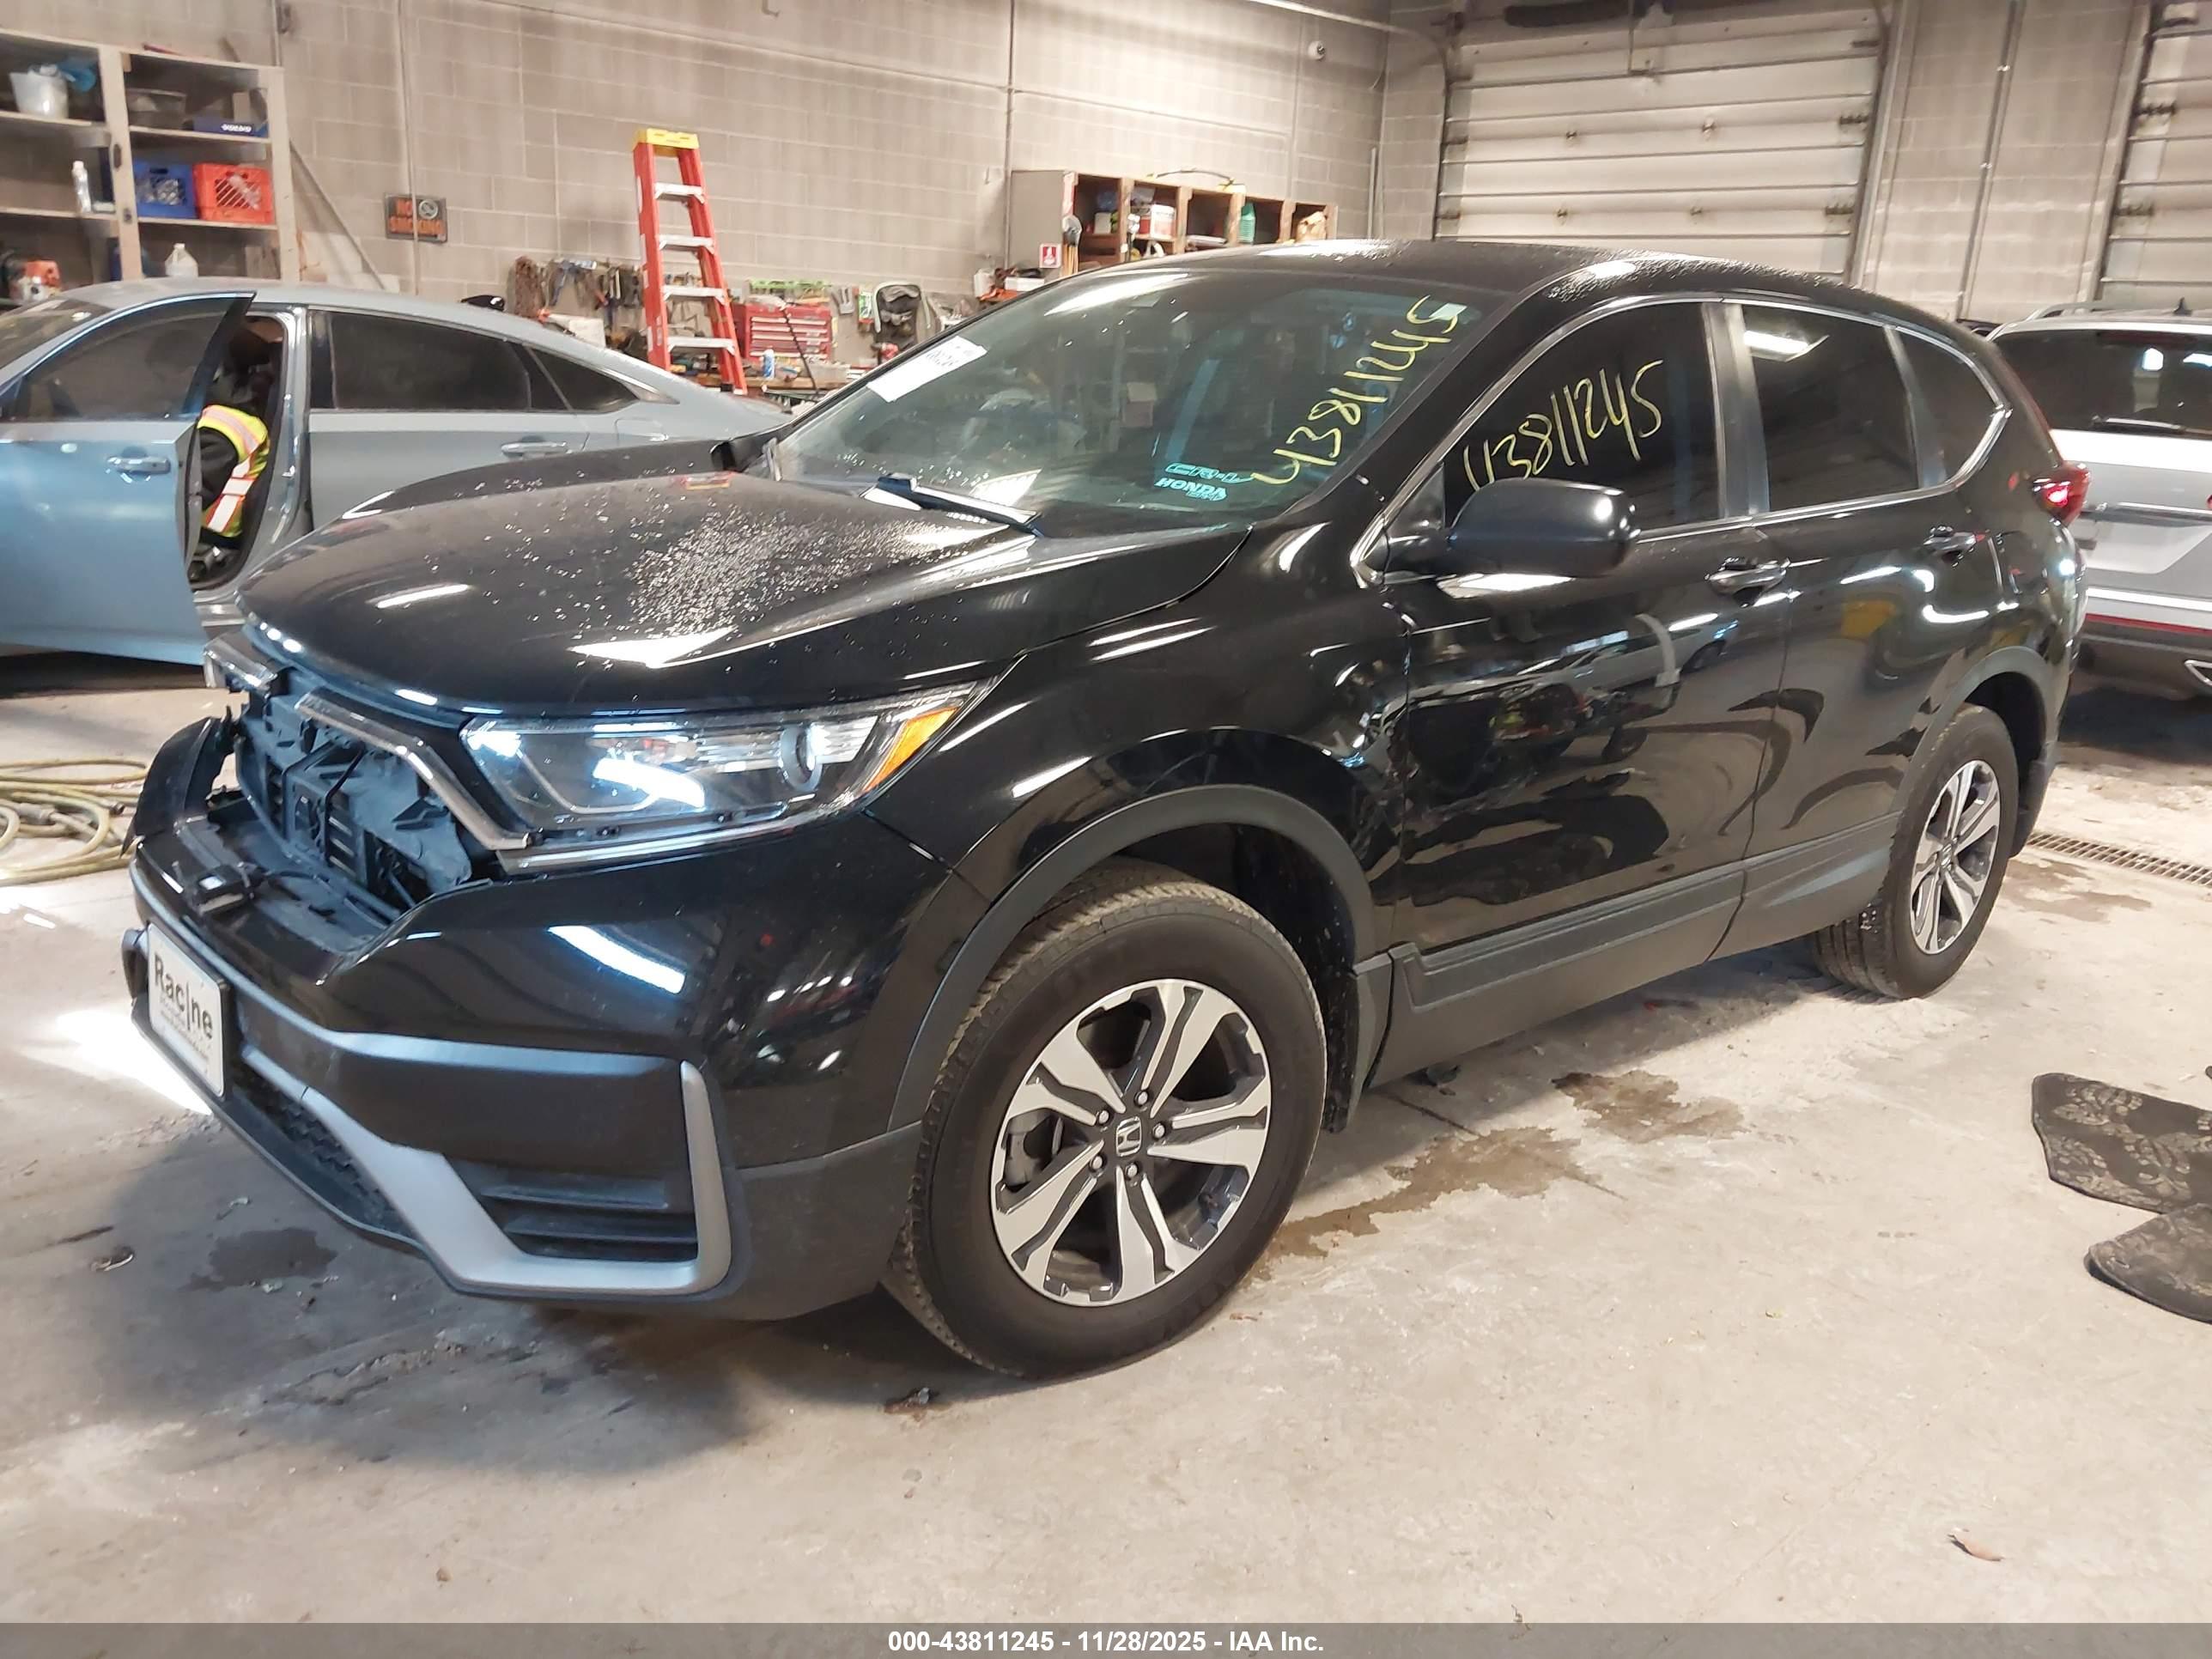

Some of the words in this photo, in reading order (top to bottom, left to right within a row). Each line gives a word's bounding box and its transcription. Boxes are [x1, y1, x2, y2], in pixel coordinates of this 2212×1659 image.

[1251, 295, 1458, 484] 43811245
[1463, 360, 1663, 490] 43811245
[1153, 477, 1227, 501] HONDA
